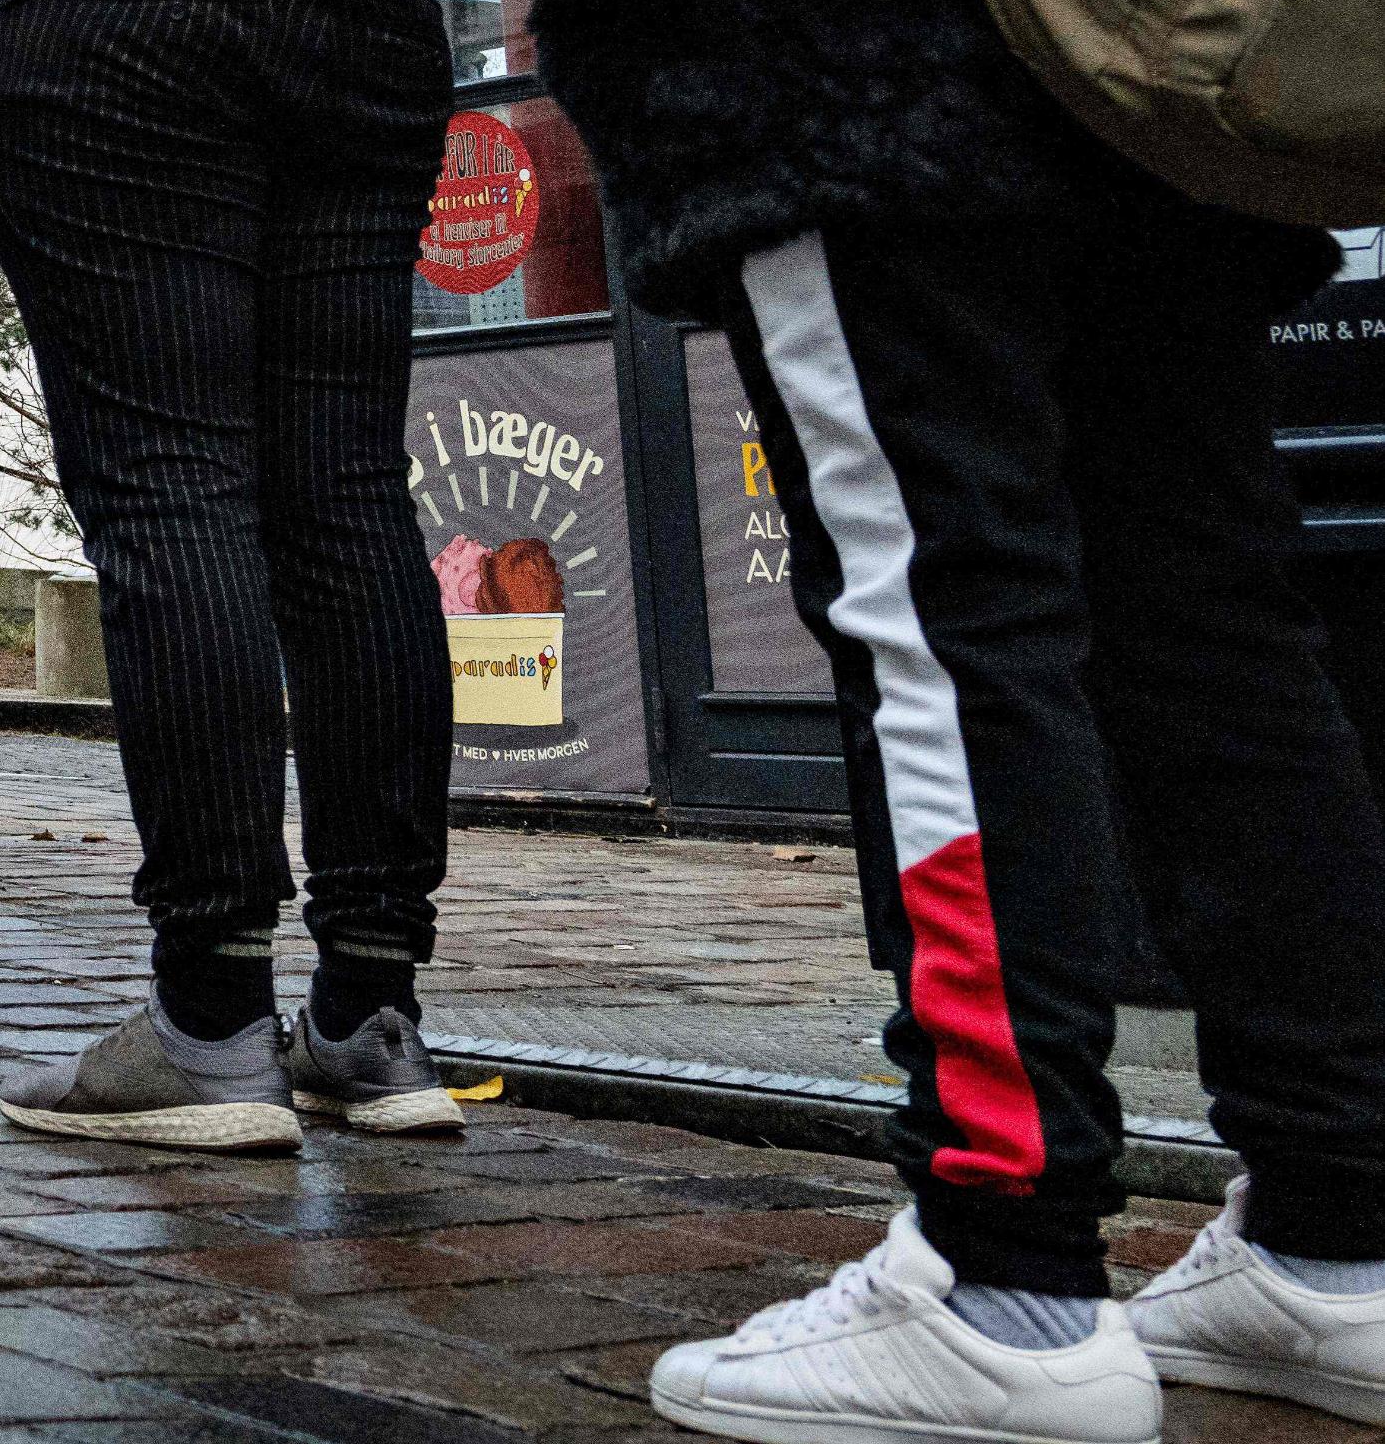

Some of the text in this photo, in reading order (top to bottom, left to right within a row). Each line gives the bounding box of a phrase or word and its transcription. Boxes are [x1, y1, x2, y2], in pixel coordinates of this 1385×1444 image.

[444, 131, 478, 180] FOR
[482, 134, 489, 176] I
[444, 217, 492, 241] henviser
[467, 232, 525, 266] storcenter
[1269, 322, 1330, 343] PAPIR
[1337, 320, 1354, 341] &
[426, 411, 451, 467] i
[459, 399, 604, 491] bæger
[450, 654, 536, 683] paradis
[463, 747, 488, 760] MED
[504, 749, 536, 762] HVER
[537, 738, 590, 761] MORGEN
